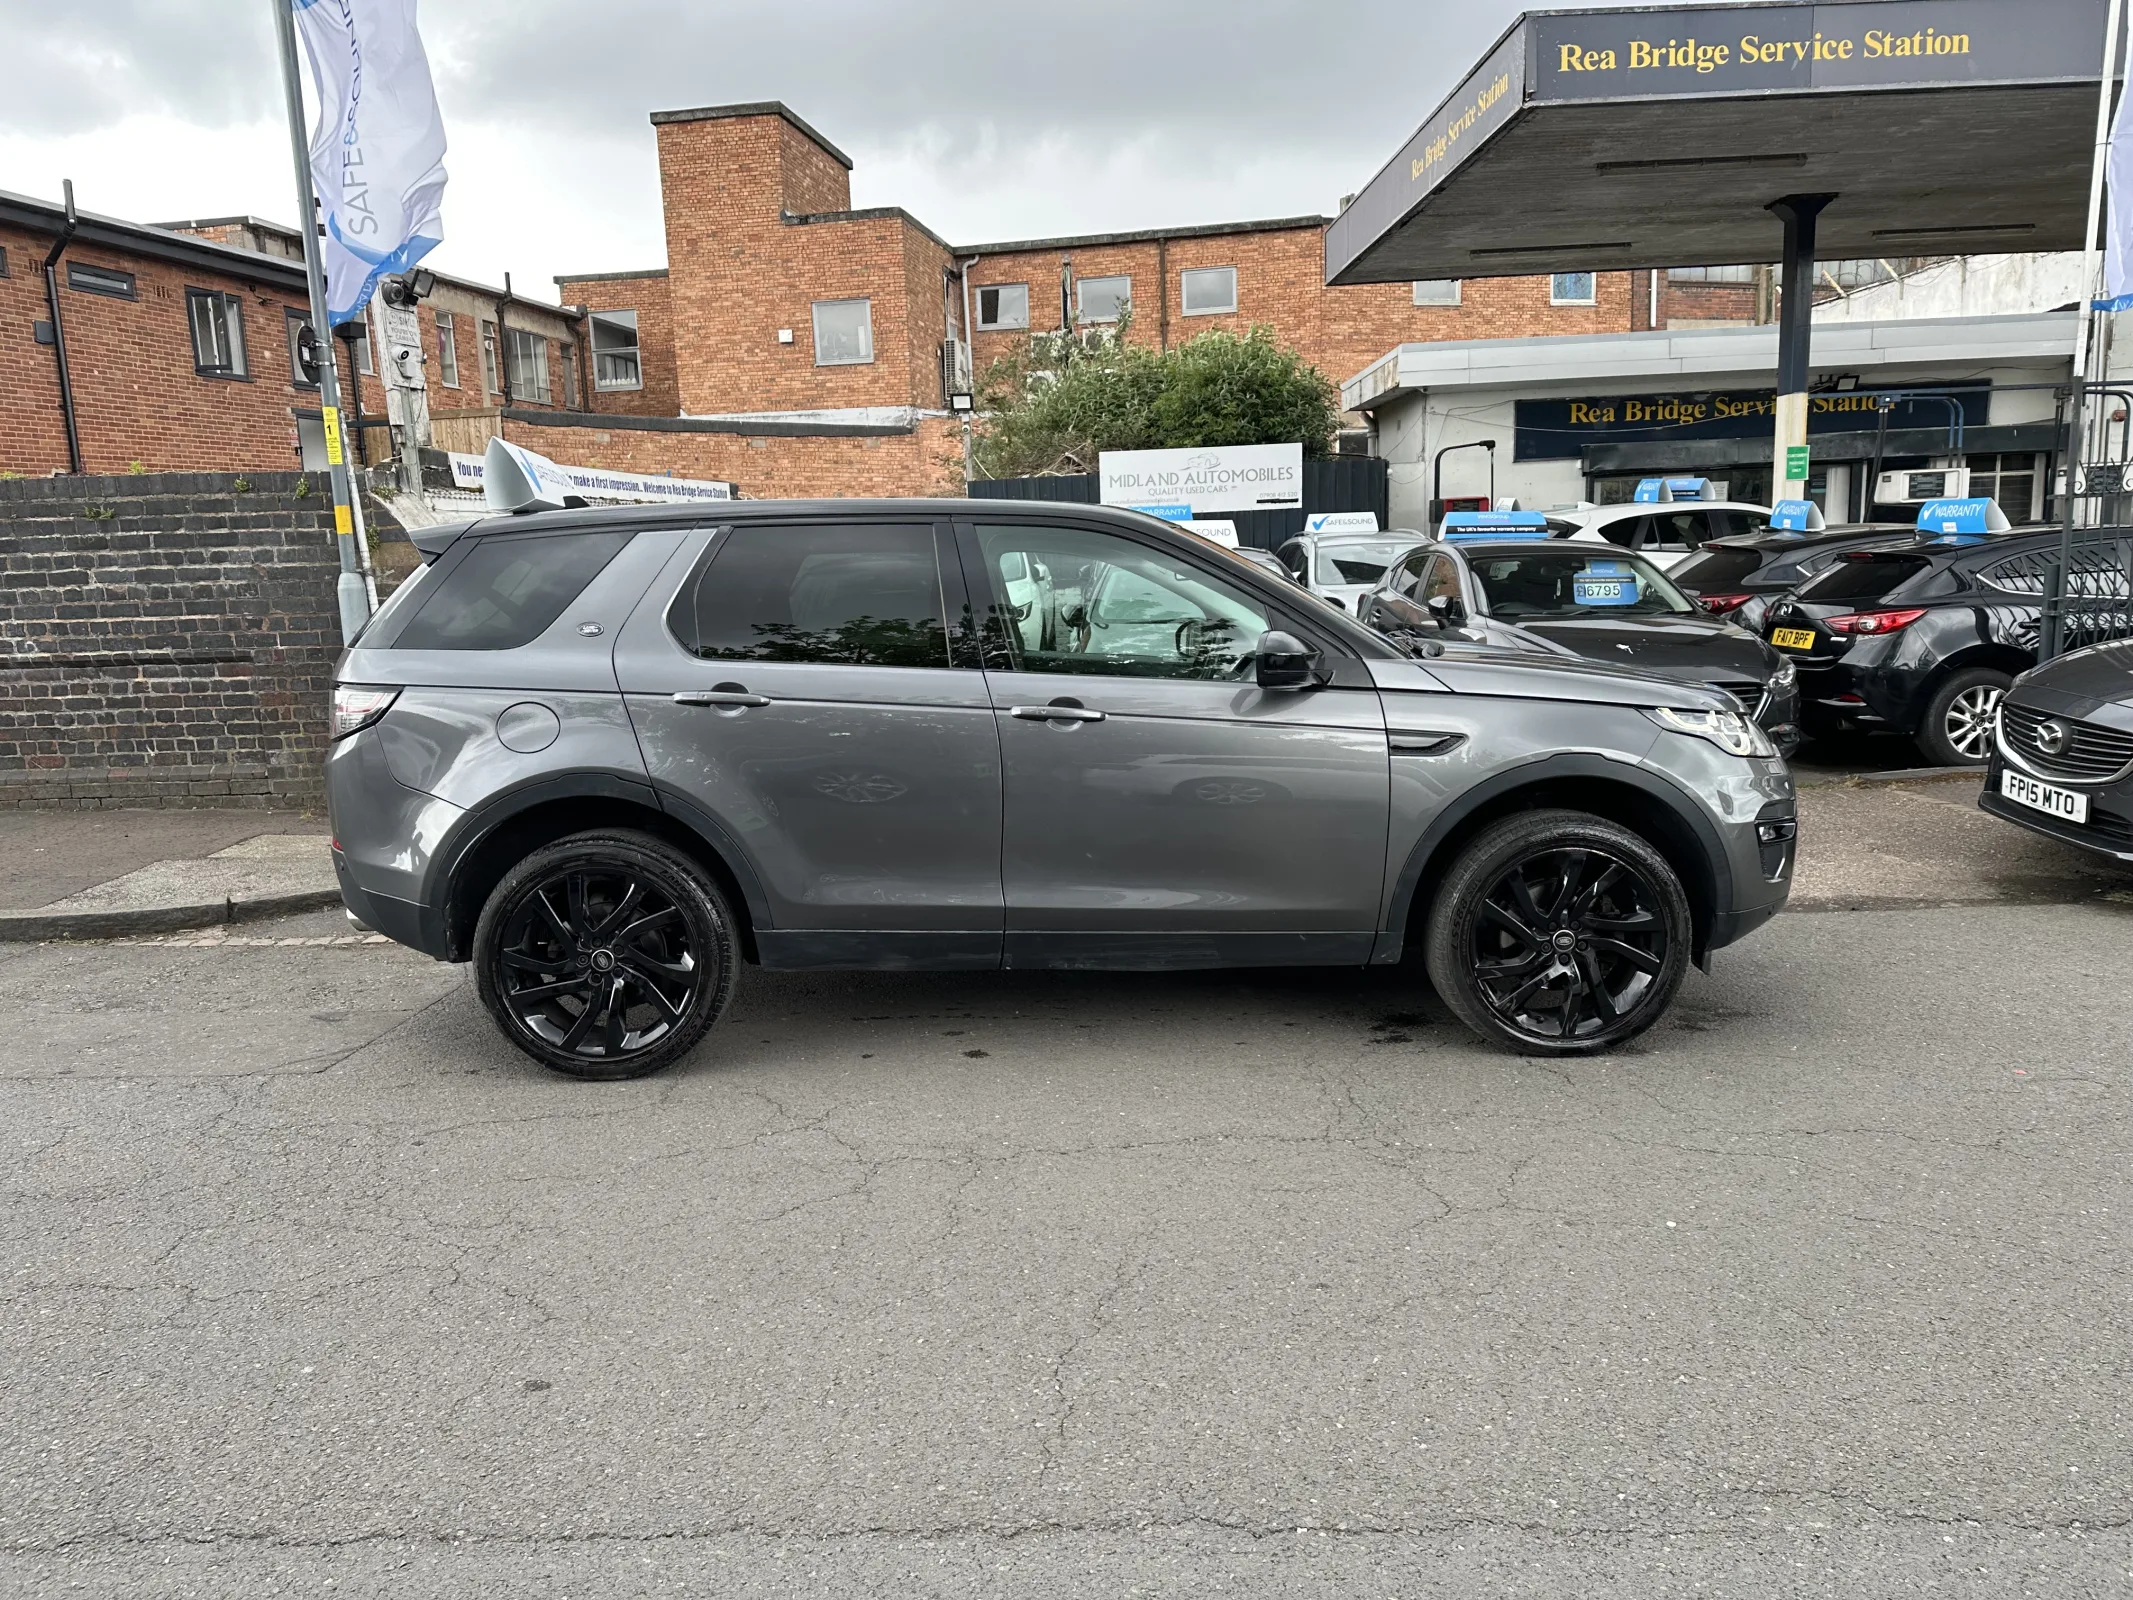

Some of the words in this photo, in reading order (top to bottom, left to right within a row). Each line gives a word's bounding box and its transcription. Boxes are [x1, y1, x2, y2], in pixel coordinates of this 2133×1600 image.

[1557, 44, 1617, 72] Rea
[1627, 38, 1730, 74] Bridge
[1740, 32, 1854, 64] Service
[1864, 27, 1970, 58] Station
[1412, 159, 1424, 182] Rea
[1425, 135, 1447, 168] Bridge
[1448, 106, 1476, 145] Service
[1478, 73, 1508, 116] Station
[1569, 402, 1616, 424] Rea
[1624, 399, 1706, 424] Bridge
[1714, 394, 1776, 417] Servi
[1813, 395, 1896, 412] Statio
[457, 461, 472, 476] You
[573, 475, 590, 488] make
[596, 476, 609, 489] first
[642, 482, 667, 494] Welcome
[672, 484, 682, 496] Rea
[682, 485, 697, 498] Bridge
[697, 486, 712, 498] Service
[712, 488, 728, 499] Station
[1109, 472, 1180, 488] MIDLAND
[1184, 466, 1294, 485] AUTOMOBILES
[1148, 486, 1184, 496] QUALITY
[1186, 486, 1205, 494] USED
[1206, 484, 1228, 493] CARS
[1935, 504, 1984, 517] WARRANTY
[1776, 630, 1794, 644] FA17
[1792, 631, 1810, 646] BPF
[2010, 774, 2039, 803] FP15
[2042, 786, 2074, 815] MTO
